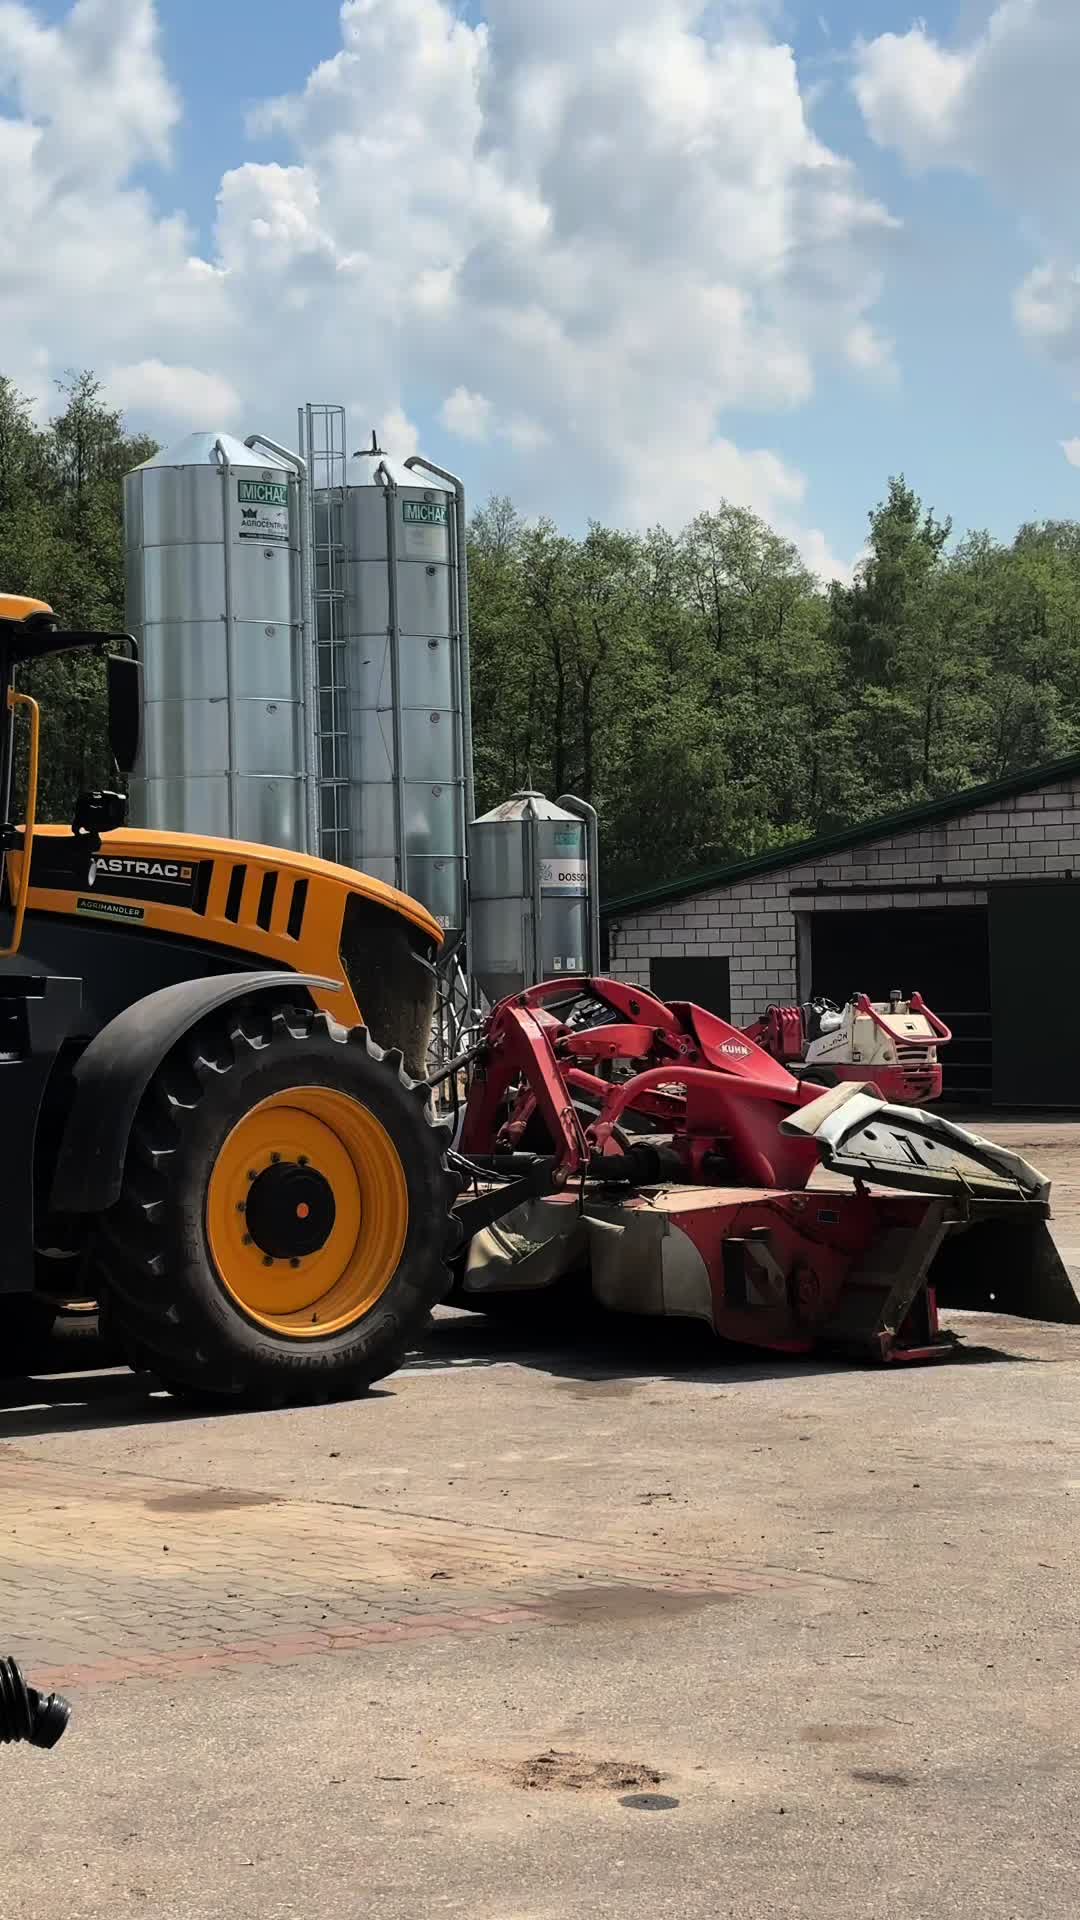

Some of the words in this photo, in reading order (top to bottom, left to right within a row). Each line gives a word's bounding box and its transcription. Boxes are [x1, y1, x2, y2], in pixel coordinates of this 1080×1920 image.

[91, 858, 179, 878] ASTRAC
[80, 900, 140, 916] AGRIHANDLER
[721, 1044, 749, 1055] KUHN
